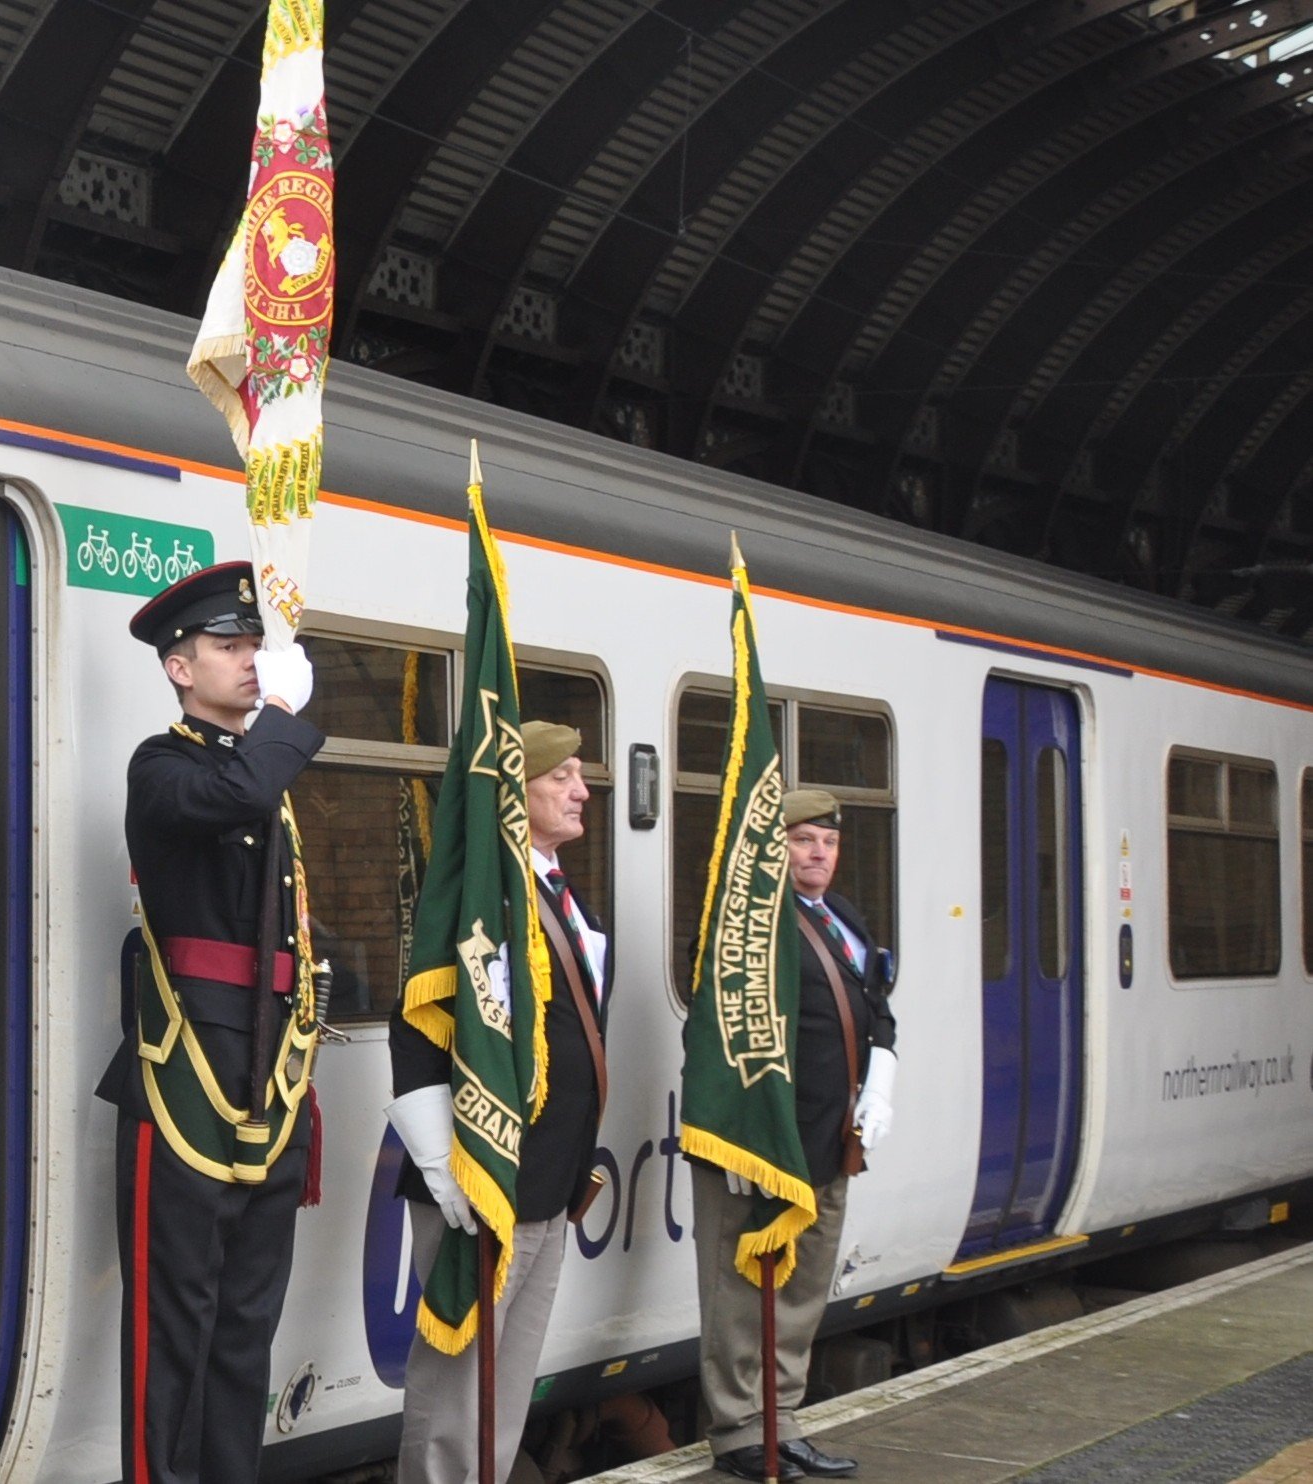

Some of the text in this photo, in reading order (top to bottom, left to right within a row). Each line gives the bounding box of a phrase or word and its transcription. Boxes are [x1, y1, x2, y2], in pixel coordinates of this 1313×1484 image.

[720, 838, 759, 978] YORKSHIRE
[722, 989, 743, 1040] THE
[746, 892, 776, 1050] REGIMENTAL
[1162, 1044, 1294, 1101] northernrailway.co.uk
